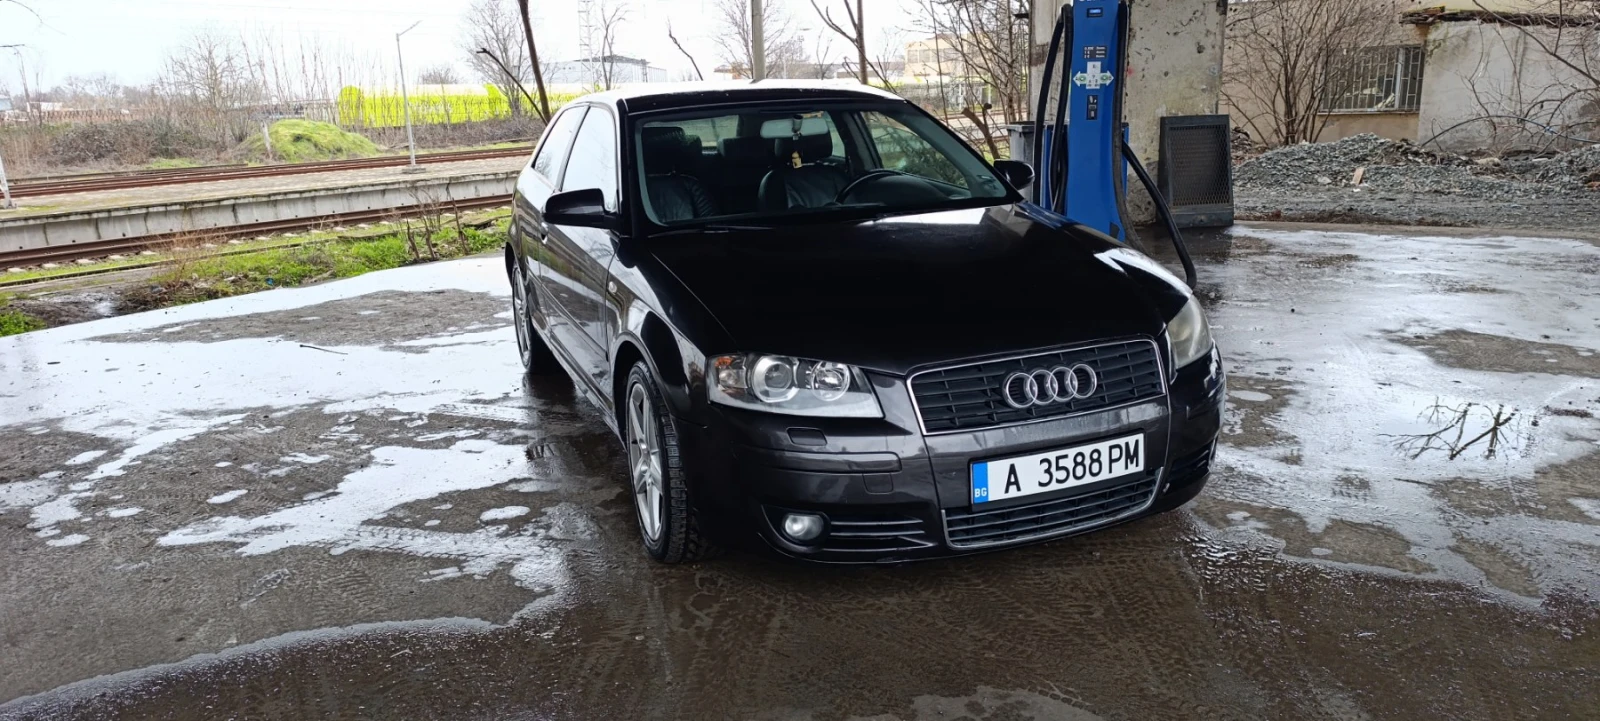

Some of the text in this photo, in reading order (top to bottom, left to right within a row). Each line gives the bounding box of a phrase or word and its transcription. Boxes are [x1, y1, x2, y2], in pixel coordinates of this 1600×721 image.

[1004, 439, 1139, 494] A 3588 PM
[974, 487, 987, 498] BG
